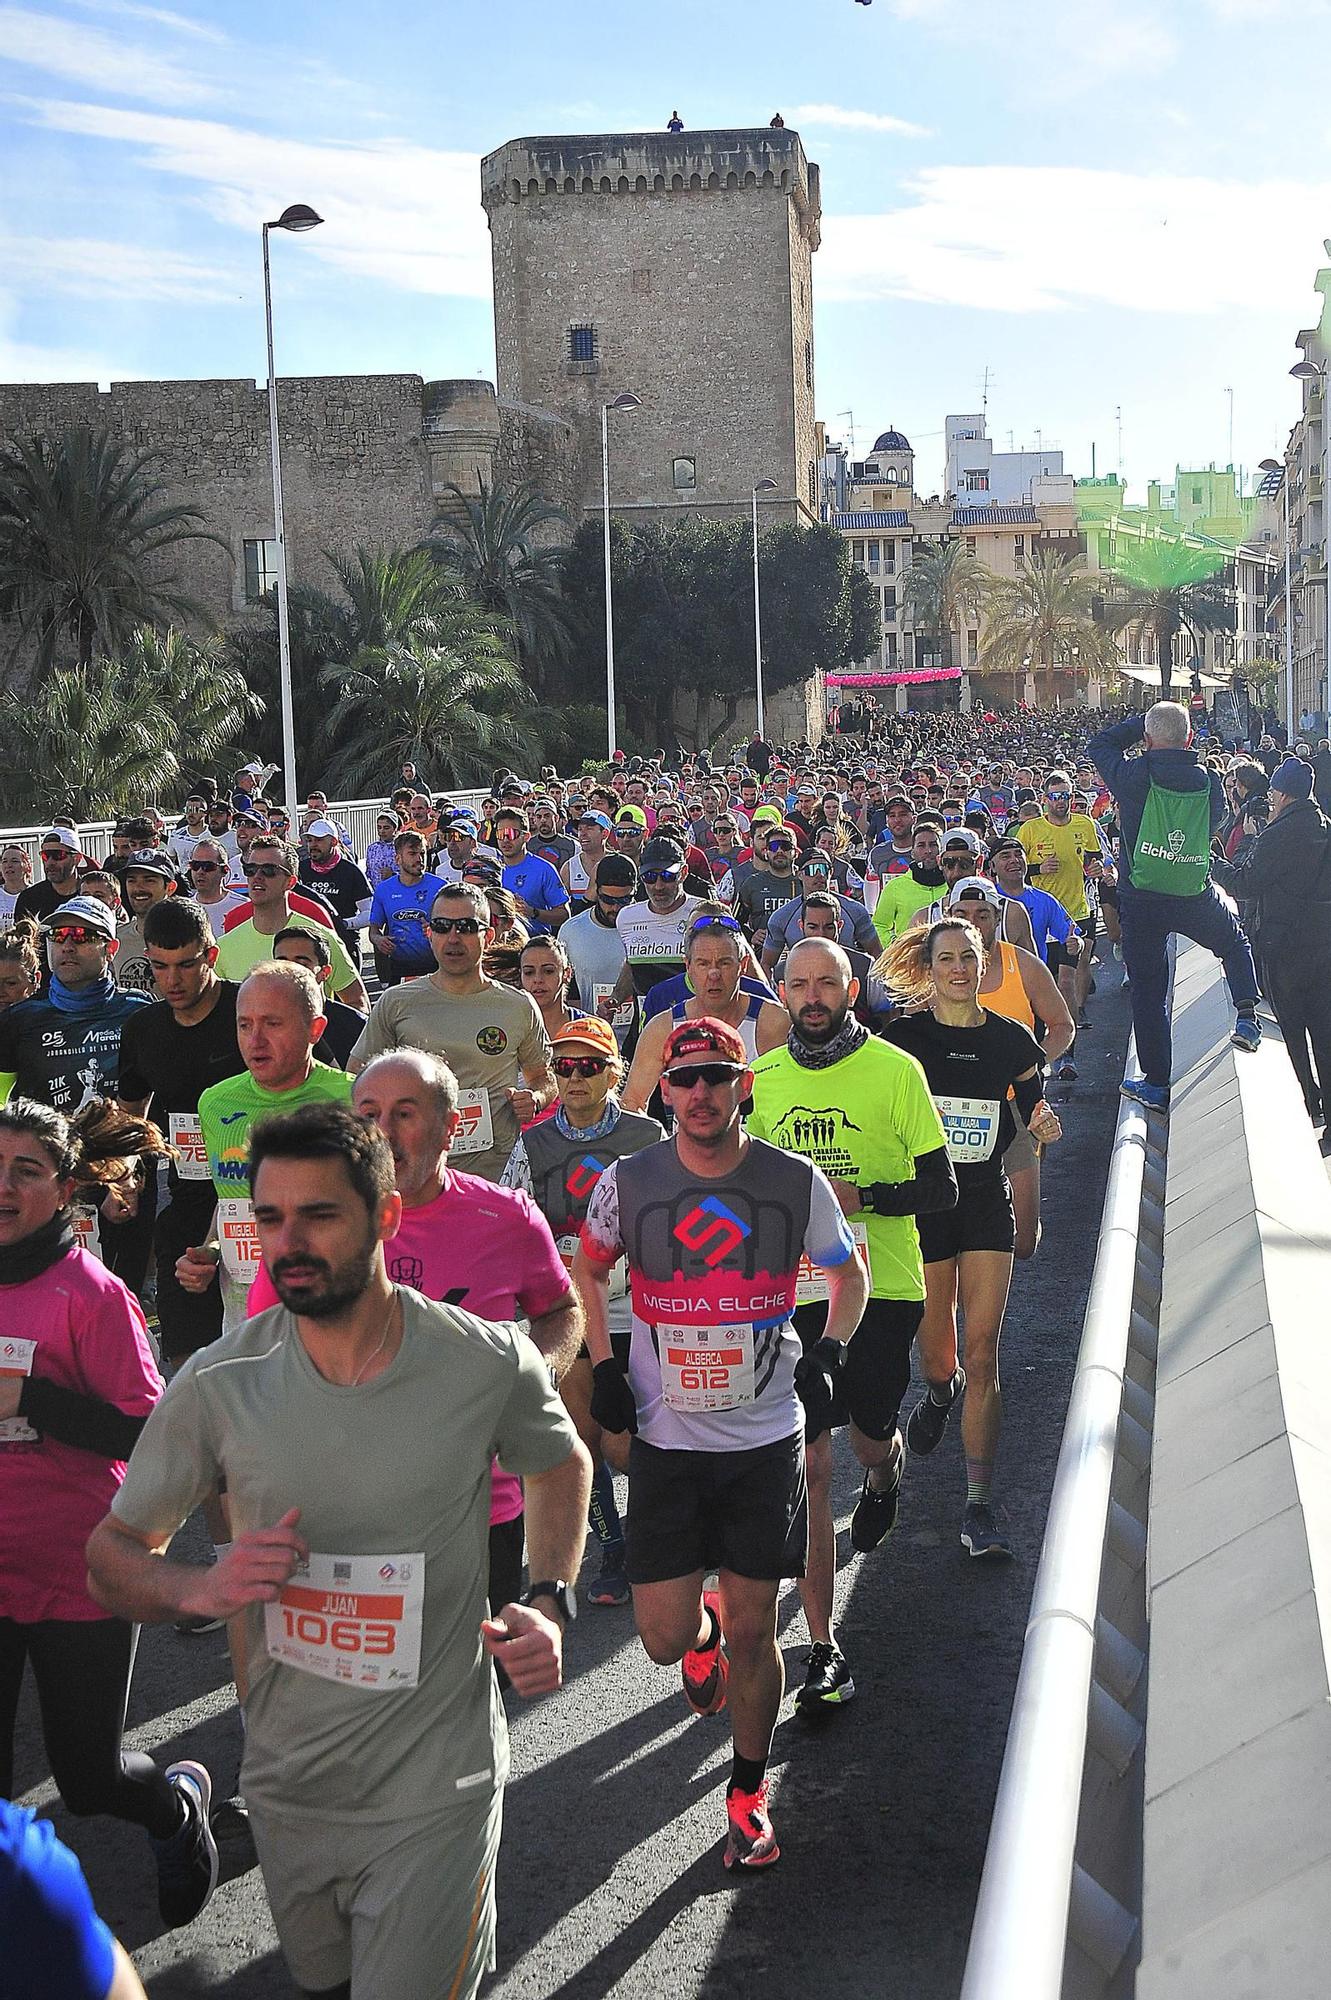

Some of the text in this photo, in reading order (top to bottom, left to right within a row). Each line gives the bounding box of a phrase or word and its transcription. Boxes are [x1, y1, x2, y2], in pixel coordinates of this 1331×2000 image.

[1141, 841, 1174, 860] Elche
[398, 911, 420, 919] Ford
[48, 1075, 66, 1090] 21K
[53, 1091, 72, 1106] 10K
[643, 1292, 787, 1313] MEDIA ELCHE
[685, 1352, 722, 1365] ALBERCA
[680, 1368, 730, 1389] 612
[321, 1594, 358, 1615] JUAN
[282, 1608, 396, 1656] 1063
